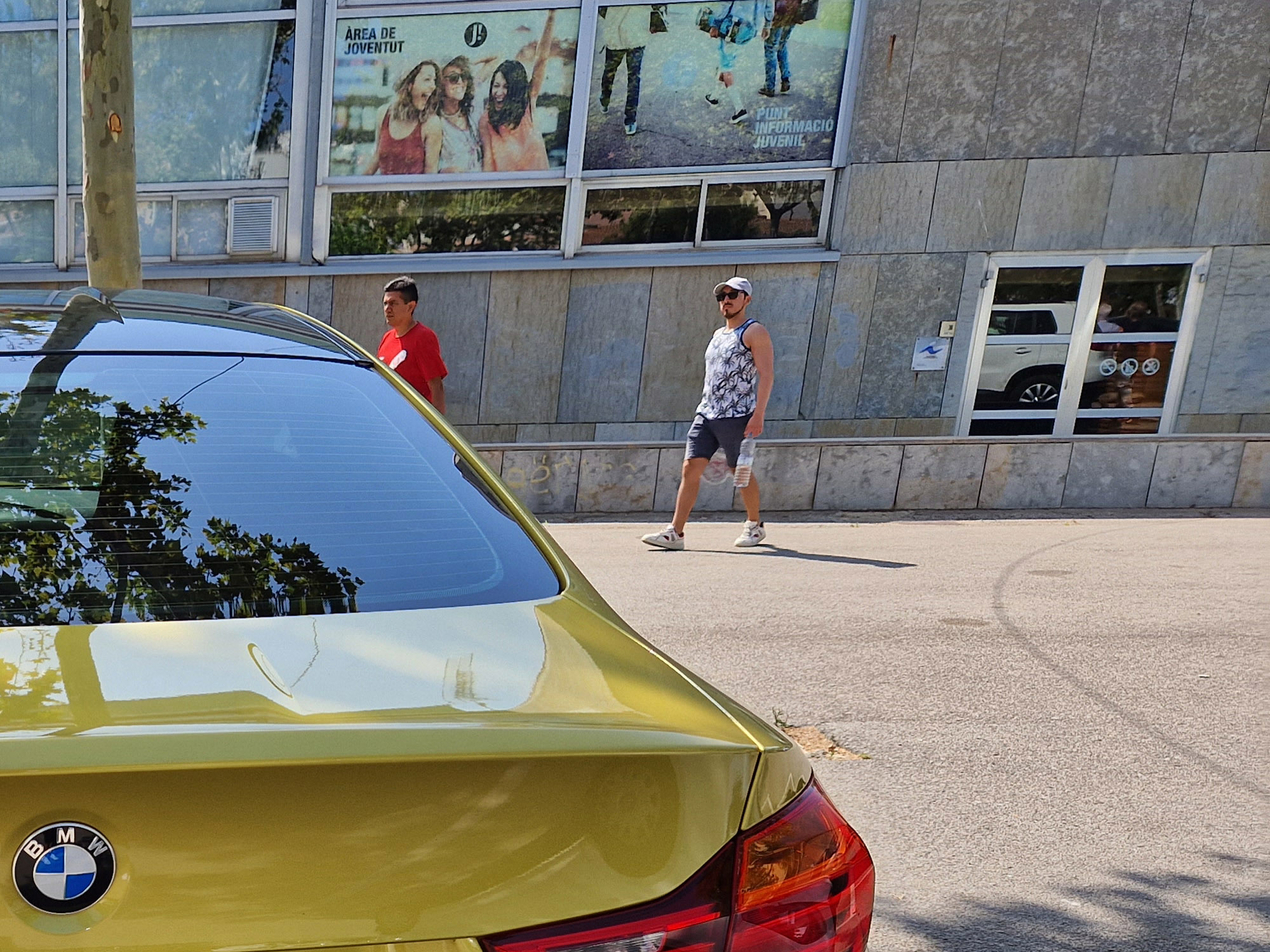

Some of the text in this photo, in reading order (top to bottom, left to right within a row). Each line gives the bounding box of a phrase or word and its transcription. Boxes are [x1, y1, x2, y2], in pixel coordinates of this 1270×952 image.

[345, 26, 396, 41] ÀREA DE
[344, 41, 405, 55] JOVENTUT
[756, 106, 791, 120] PUNT
[754, 116, 835, 135] INFORMACIÓ
[753, 134, 803, 149] JUVENIL
[23, 827, 108, 860] BMW
